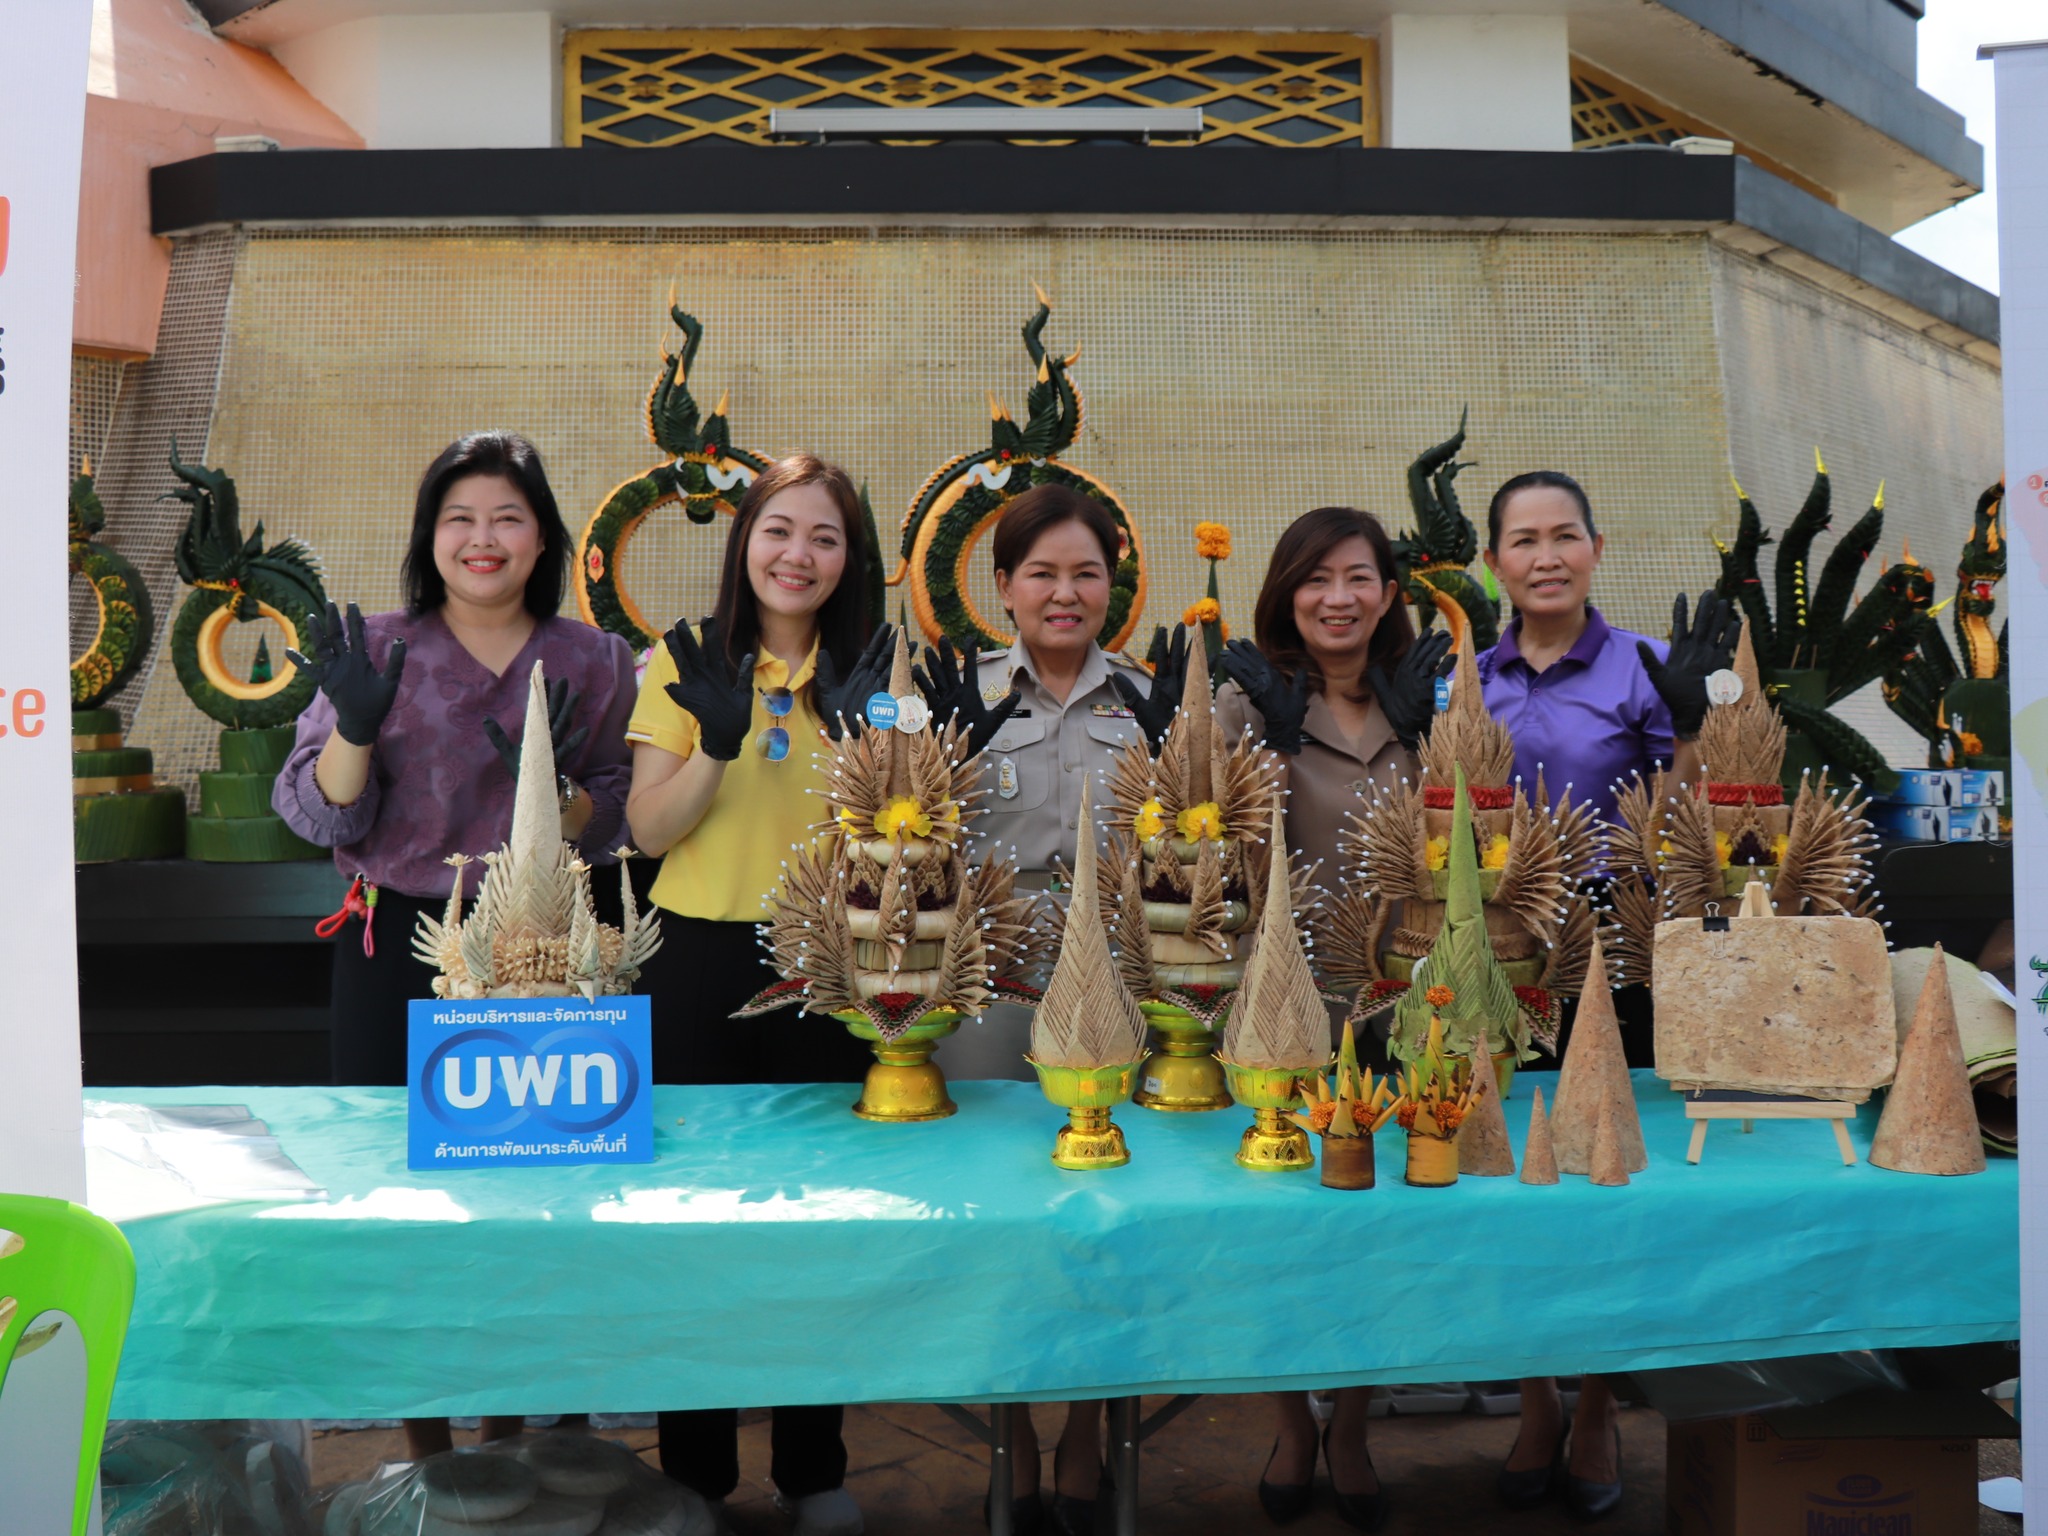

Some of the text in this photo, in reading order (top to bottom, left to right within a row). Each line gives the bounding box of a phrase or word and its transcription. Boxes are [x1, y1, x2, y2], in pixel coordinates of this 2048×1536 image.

[433, 1008, 627, 1026] หน่วยบริหารและจัดการทุน
[444, 1052, 618, 1110] บพท
[434, 1133, 627, 1158] ด้านการพัฒนาระดับพื้นที่
